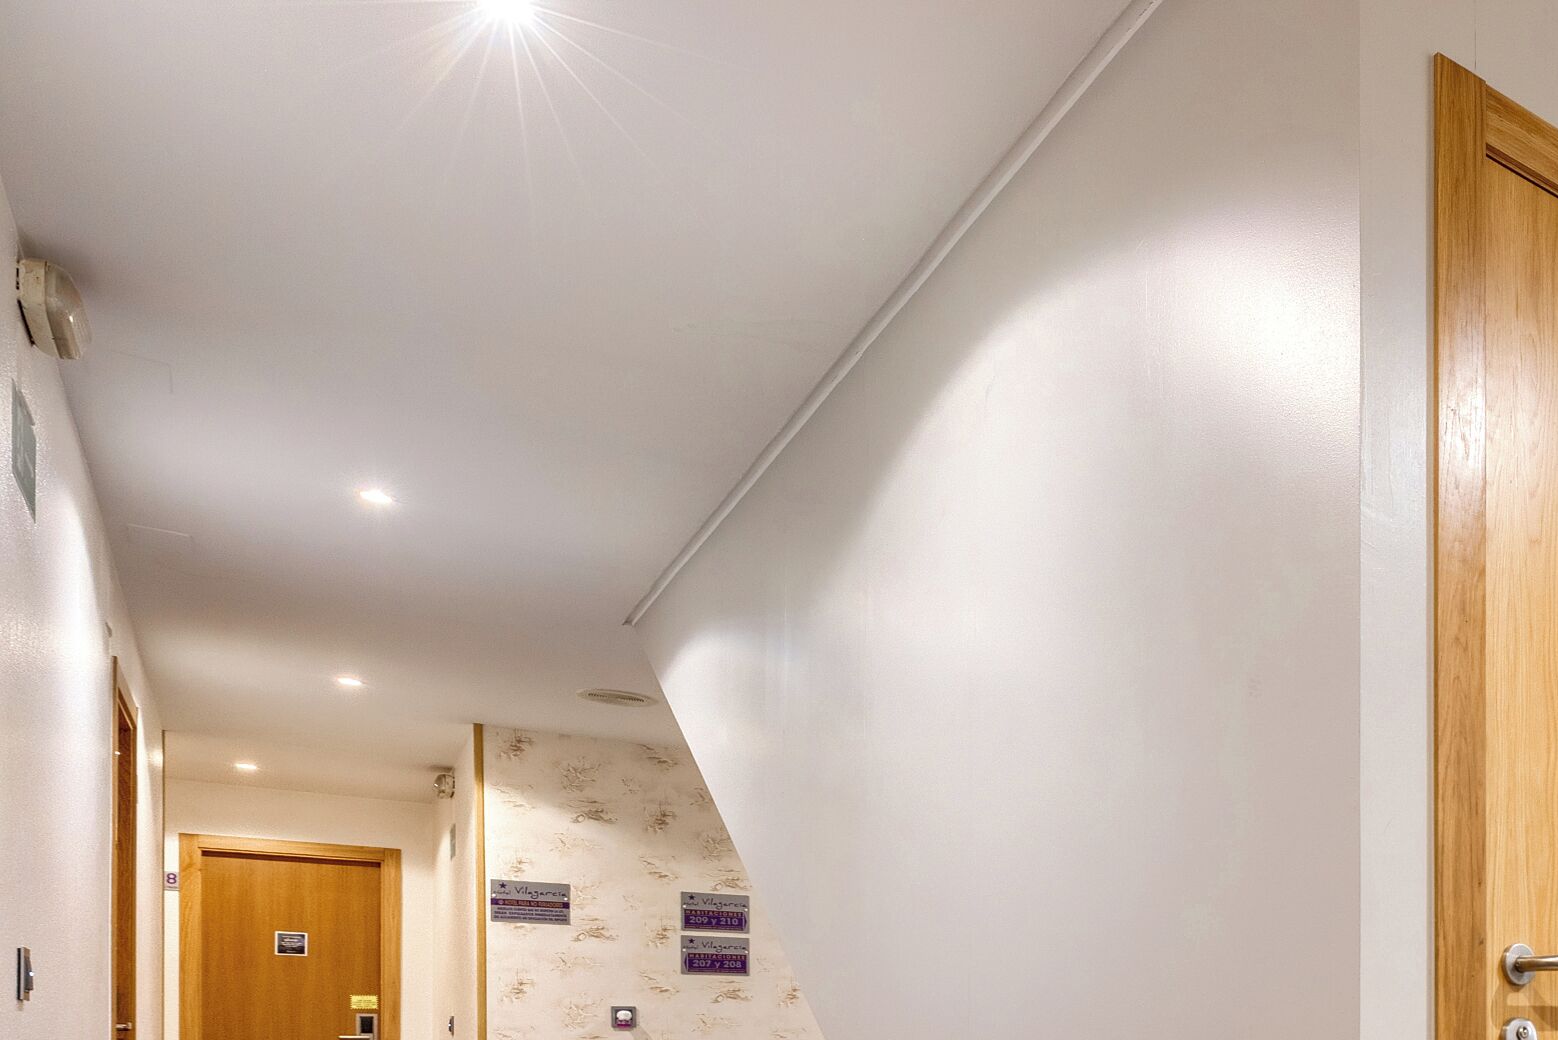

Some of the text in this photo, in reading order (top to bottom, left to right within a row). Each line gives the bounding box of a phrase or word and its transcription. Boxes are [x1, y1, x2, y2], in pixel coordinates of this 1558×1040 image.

[689, 916, 739, 926] 209 y 210
[692, 959, 742, 969] 207 y 208
